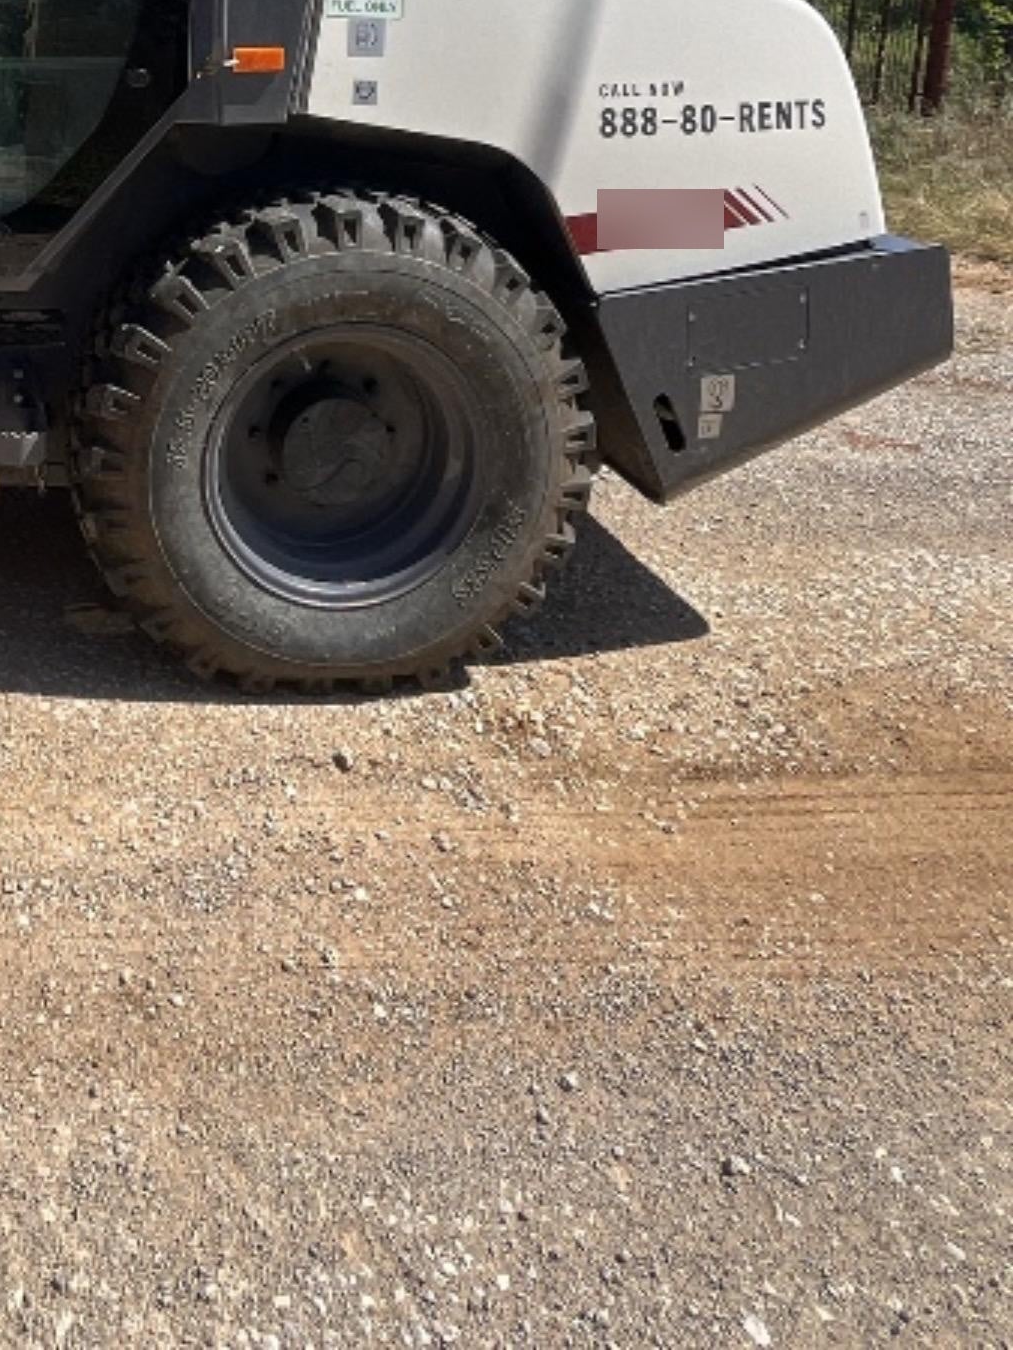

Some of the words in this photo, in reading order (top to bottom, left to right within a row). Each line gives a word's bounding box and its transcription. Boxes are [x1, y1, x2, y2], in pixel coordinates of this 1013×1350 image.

[598, 83, 641, 98] CALL
[649, 80, 685, 97] NOW
[599, 98, 826, 139] 888-80-RENTS
